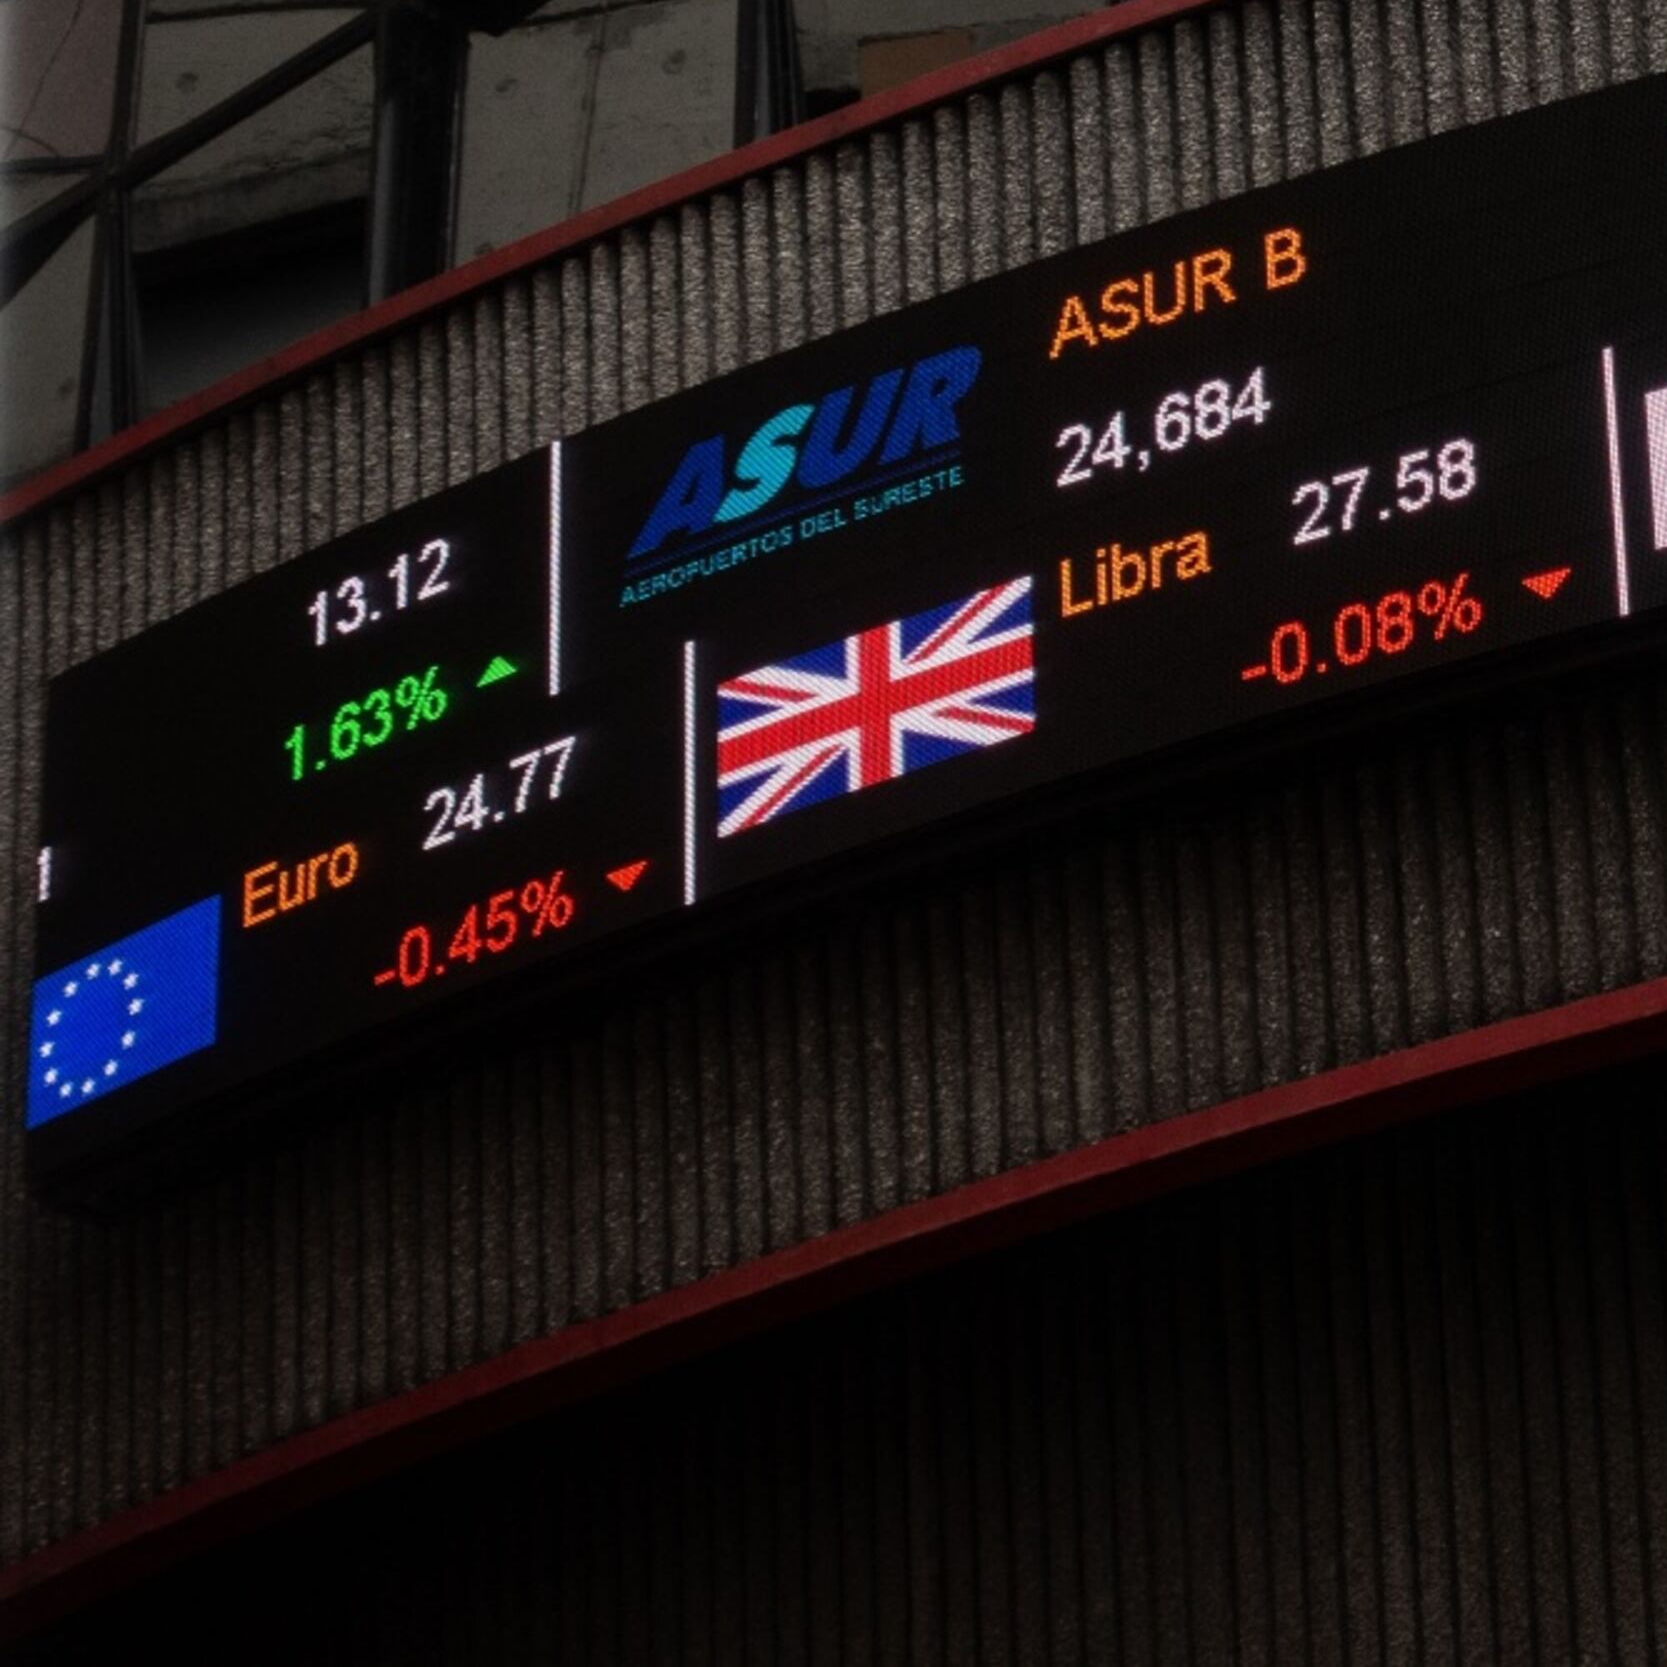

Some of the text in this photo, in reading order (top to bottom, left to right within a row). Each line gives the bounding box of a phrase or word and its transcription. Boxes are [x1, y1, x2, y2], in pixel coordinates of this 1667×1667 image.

[1049, 227, 1308, 359] ASUR B
[625, 344, 983, 561] ASUR
[1056, 366, 1273, 488] 24,684
[618, 465, 966, 609] AEROPUERTOS DEL SURESTE
[1291, 437, 1477, 547] 27.58
[308, 538, 451, 647] 13.12
[1060, 530, 1213, 618] Libra
[1240, 572, 1484, 684] -0.08%
[284, 665, 449, 781] 1.63%
[421, 735, 578, 852] 24.77
[242, 841, 360, 929] Euro
[373, 870, 576, 989] -0.45%
